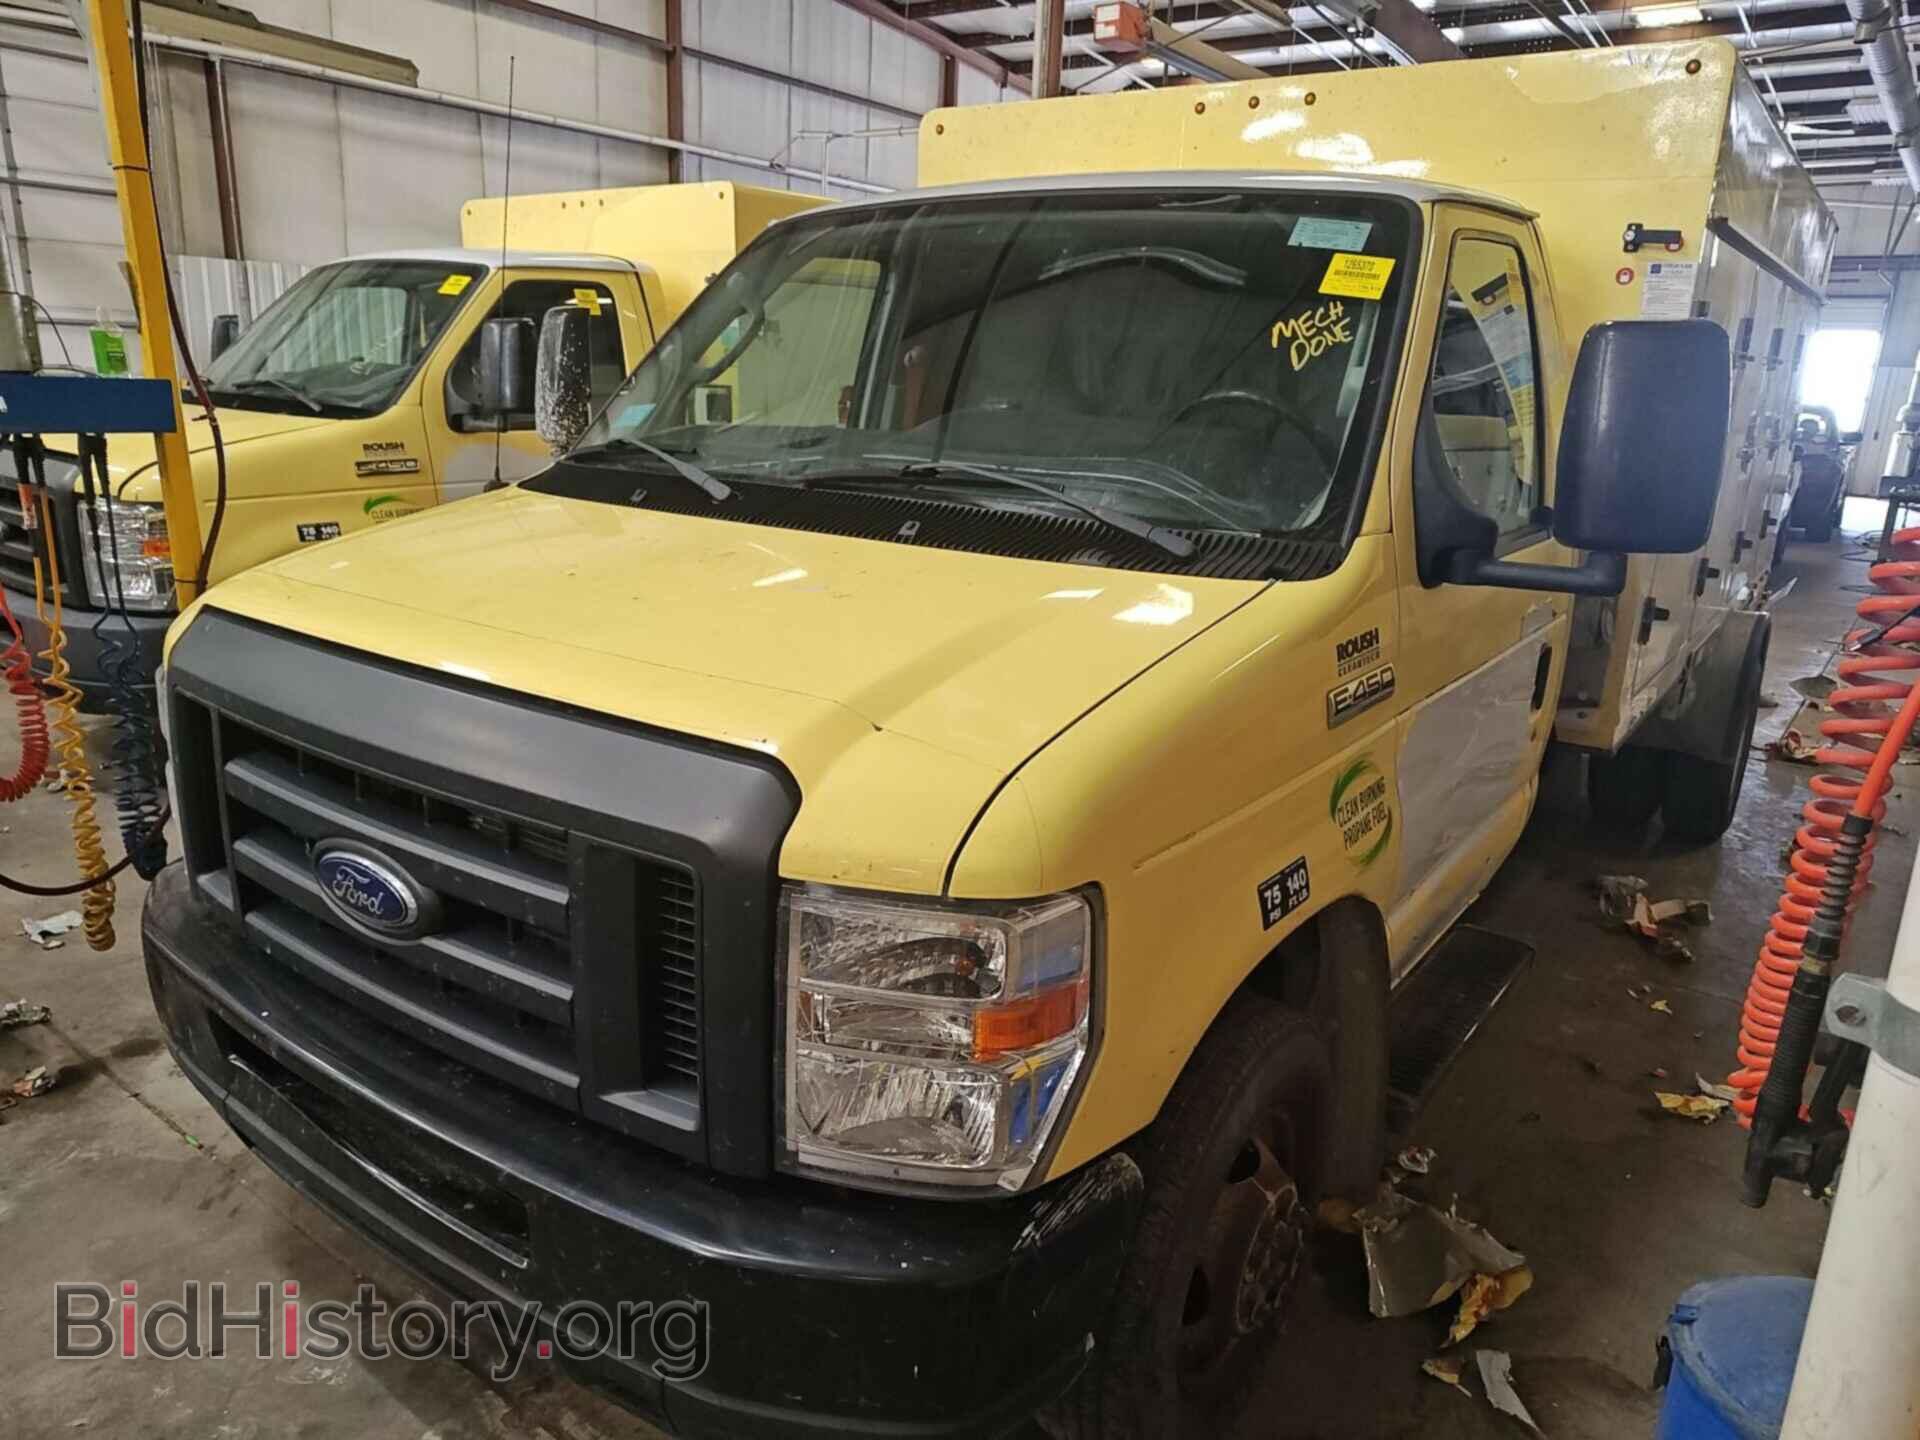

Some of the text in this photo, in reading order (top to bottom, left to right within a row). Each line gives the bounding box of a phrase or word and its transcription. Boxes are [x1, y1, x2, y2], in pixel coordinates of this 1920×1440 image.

[1271, 301, 1345, 348] MECH
[1290, 317, 1354, 371] DONE
[362, 441, 405, 451] ROUSH
[1336, 628, 1380, 662] ROUSH
[1337, 650, 1381, 678] CLEANTECH
[1337, 776, 1386, 828] CLEAN BURNING
[1343, 801, 1388, 850] PROPANE FUEL
[331, 866, 385, 915] Ford
[1263, 884, 1282, 910] 75
[1286, 869, 1307, 896] 140
[1268, 907, 1282, 923] PSI
